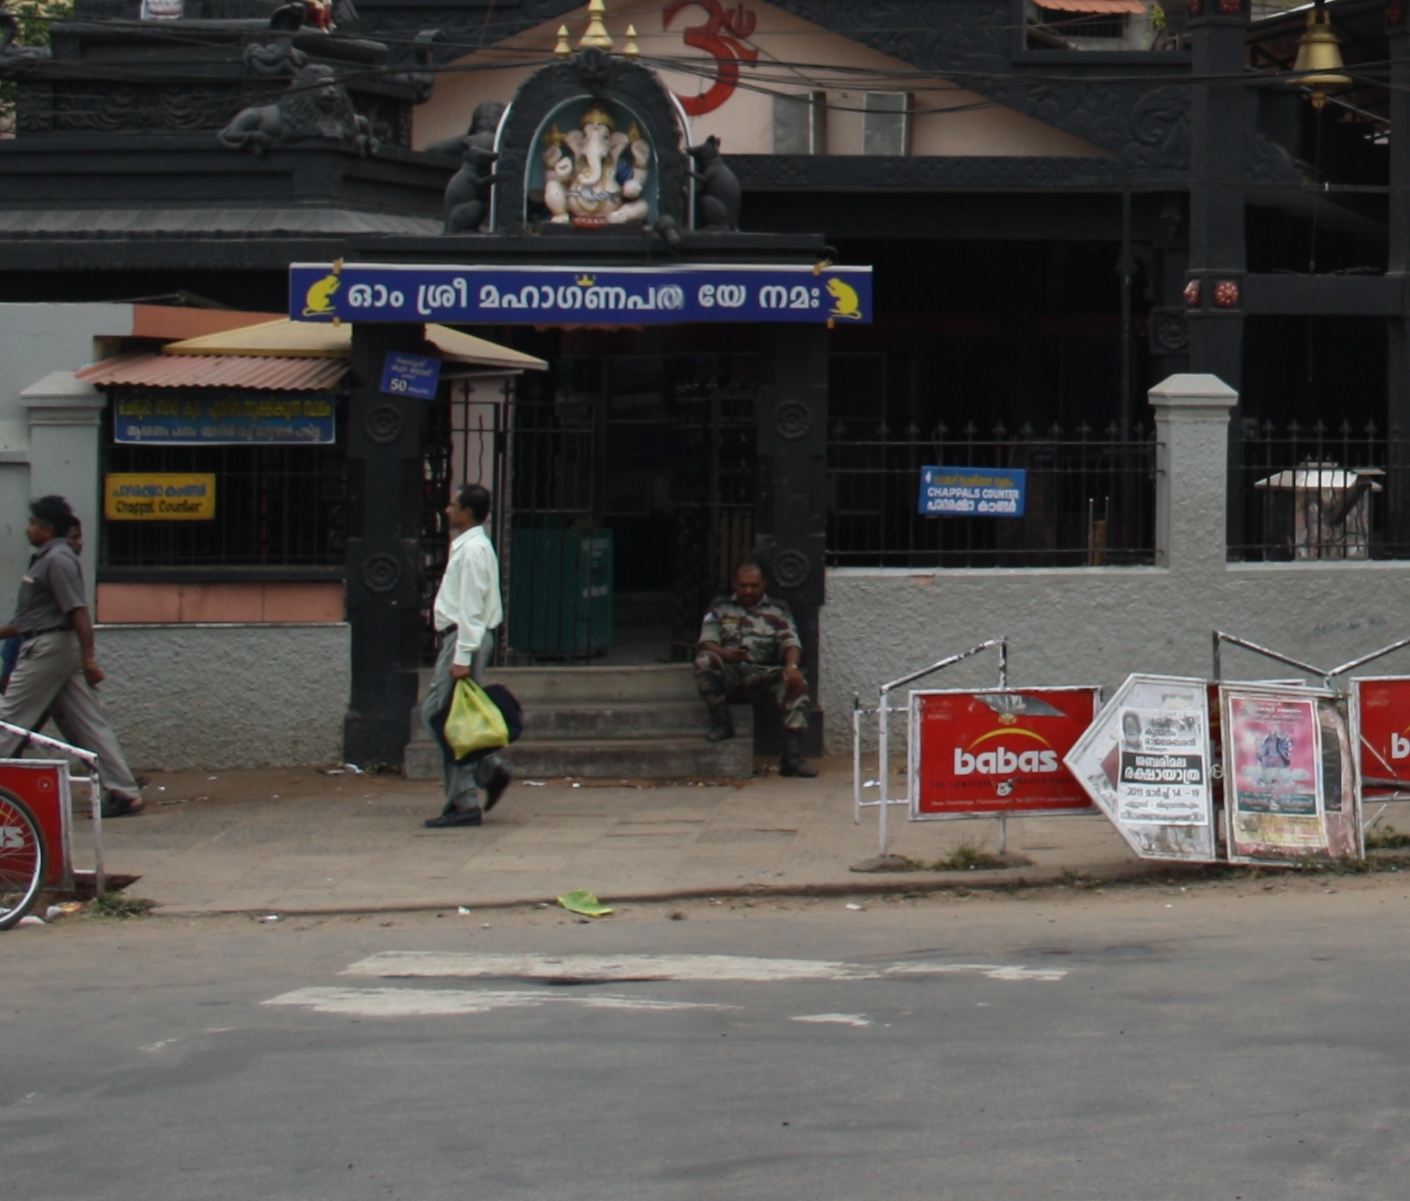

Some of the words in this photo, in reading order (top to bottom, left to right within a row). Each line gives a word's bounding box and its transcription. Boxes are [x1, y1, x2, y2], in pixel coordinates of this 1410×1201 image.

[347, 285, 404, 309] ഓം
[418, 277, 467, 316] ശ്രീ
[390, 378, 408, 392] 50
[927, 487, 980, 499] CHAPPALS
[982, 489, 1020, 500] COUNTER
[953, 747, 1059, 776] babas
